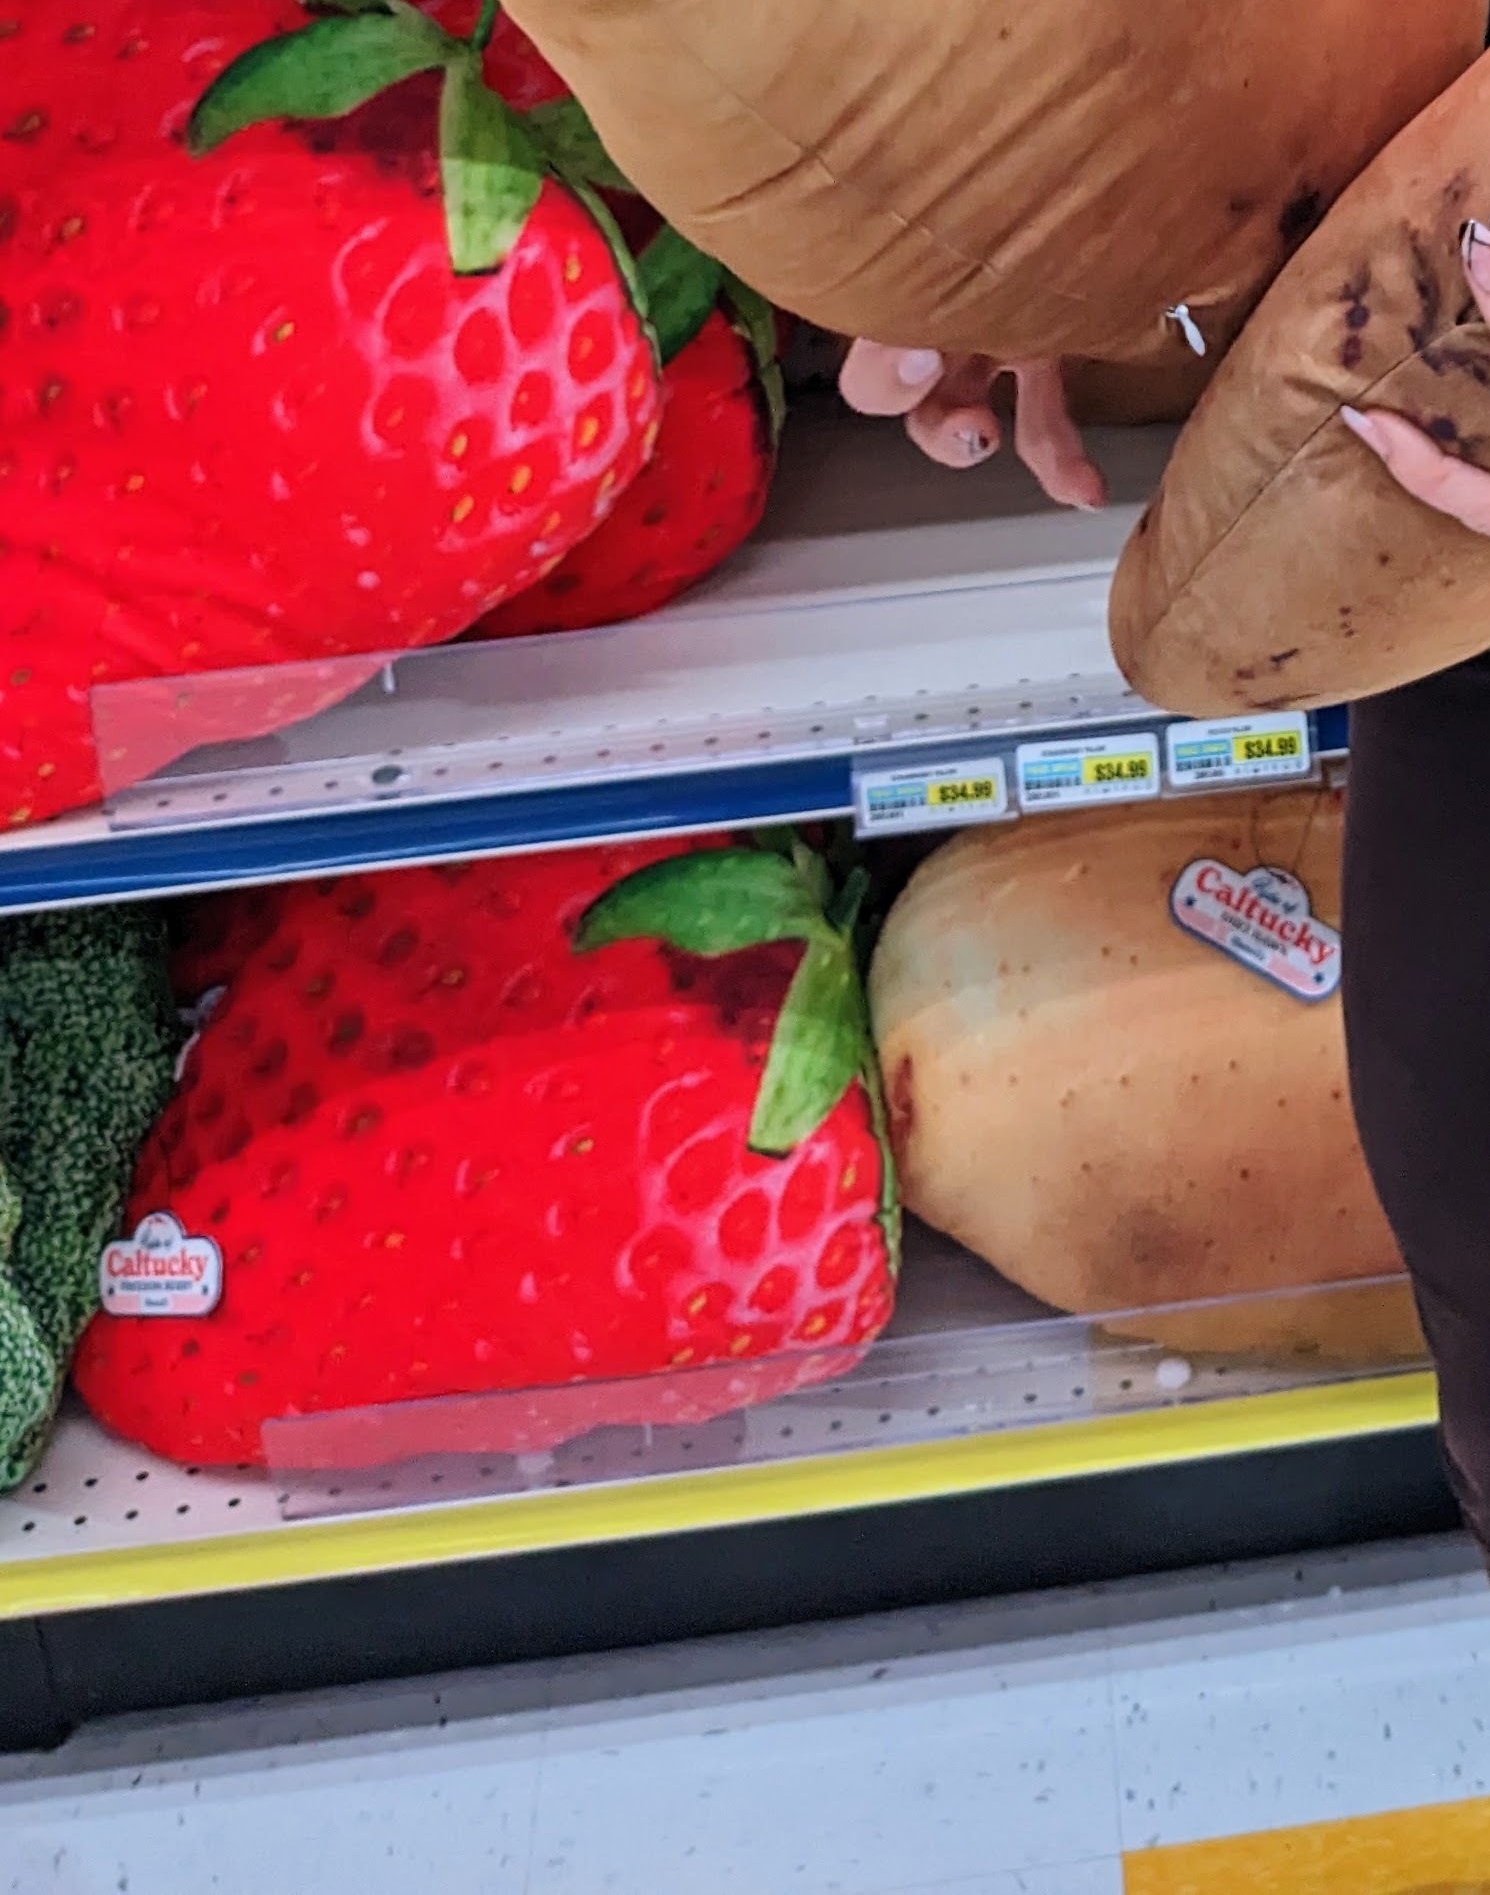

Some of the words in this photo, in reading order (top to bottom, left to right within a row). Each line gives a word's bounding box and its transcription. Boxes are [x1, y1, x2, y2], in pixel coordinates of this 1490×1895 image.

[1245, 735, 1297, 759] $34.99
[1095, 758, 1148, 782] $34.99
[939, 780, 993, 803] $34.99
[1196, 866, 1335, 965] Caltucky
[107, 1248, 206, 1282] Caltucky
